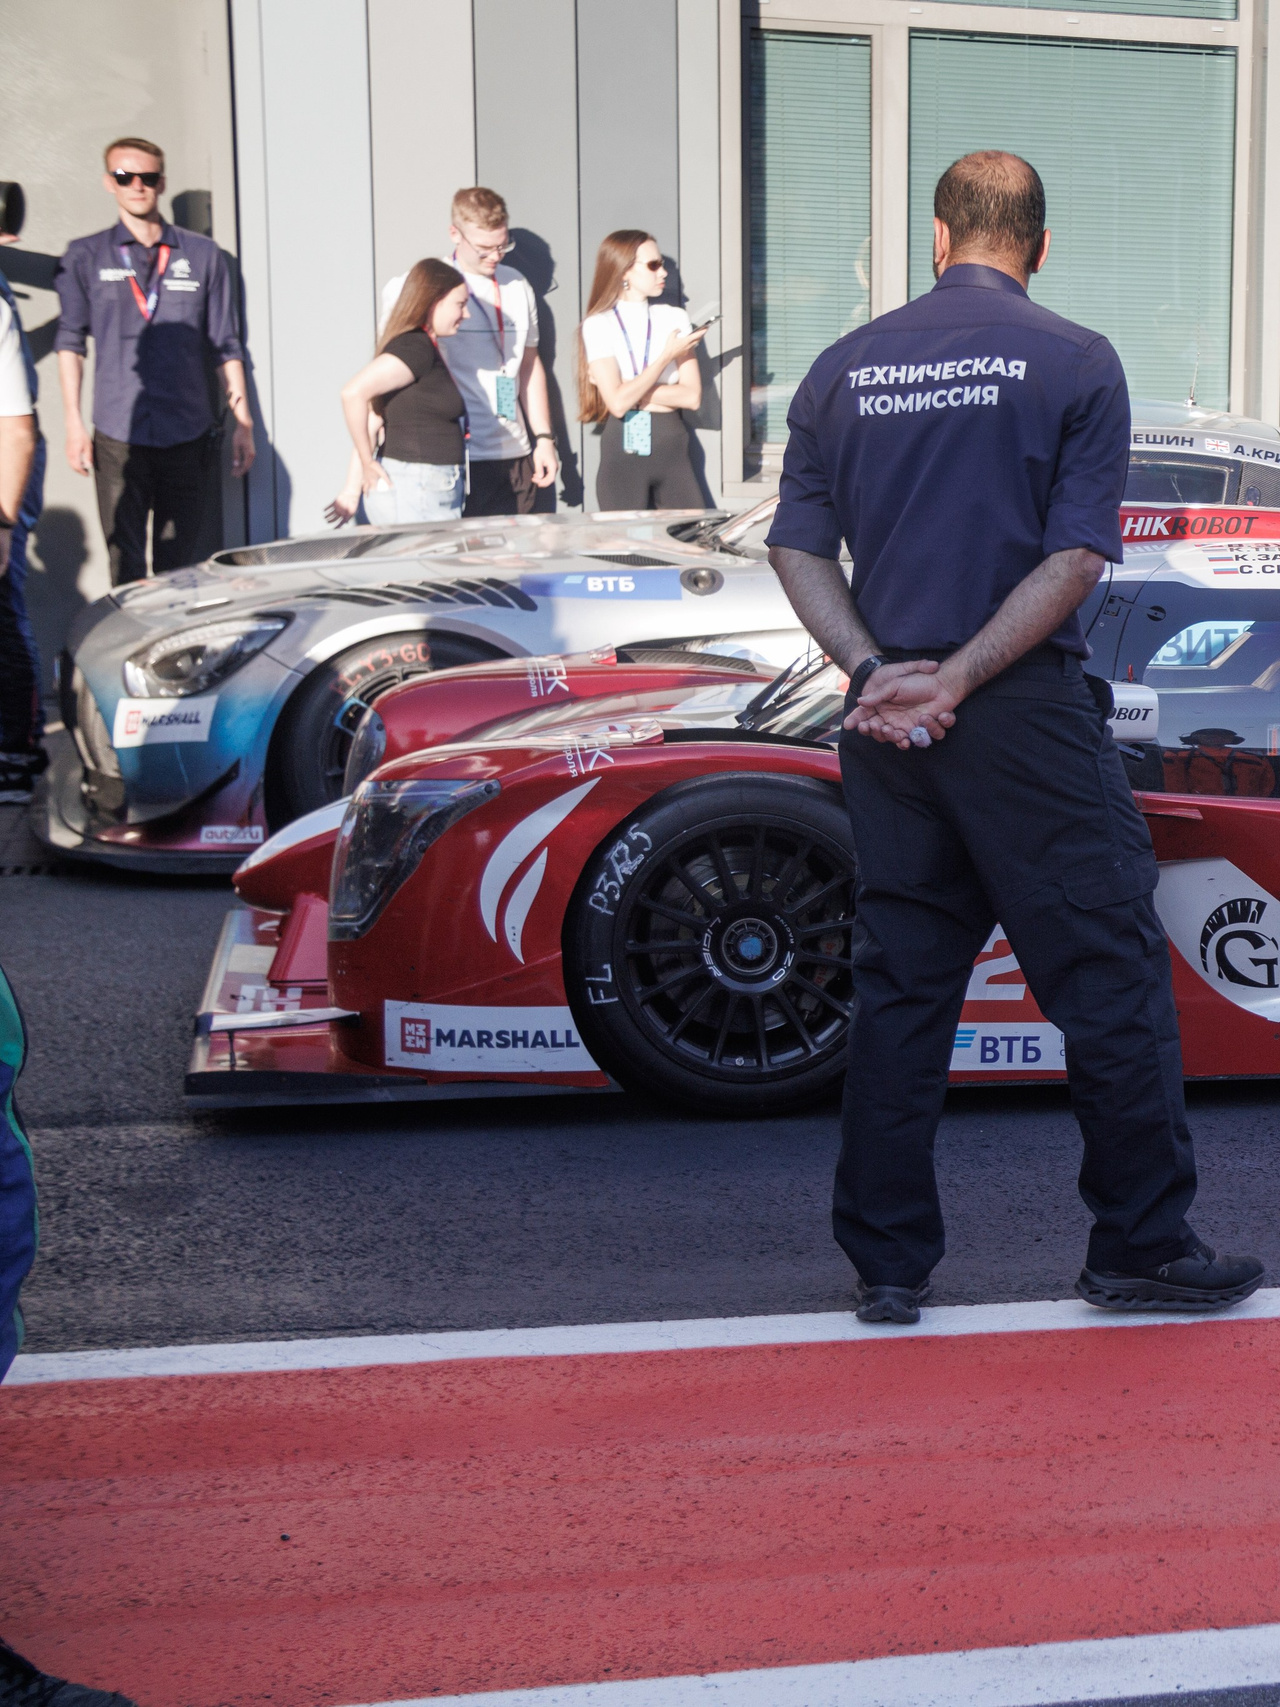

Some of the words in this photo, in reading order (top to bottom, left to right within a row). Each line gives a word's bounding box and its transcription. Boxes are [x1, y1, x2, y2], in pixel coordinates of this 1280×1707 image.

[849, 357, 1026, 389] ТЕХНИЧЕСКАЯ
[859, 386, 999, 416] КОМИССИЯ
[1131, 433, 1194, 448] ЕШИН
[1123, 516, 1259, 537] HIKROBOT
[587, 576, 635, 592] ВТБ
[585, 963, 619, 1005] FL
[435, 1029, 580, 1049] MARSHALL
[981, 1036, 1042, 1063] ВТБ
